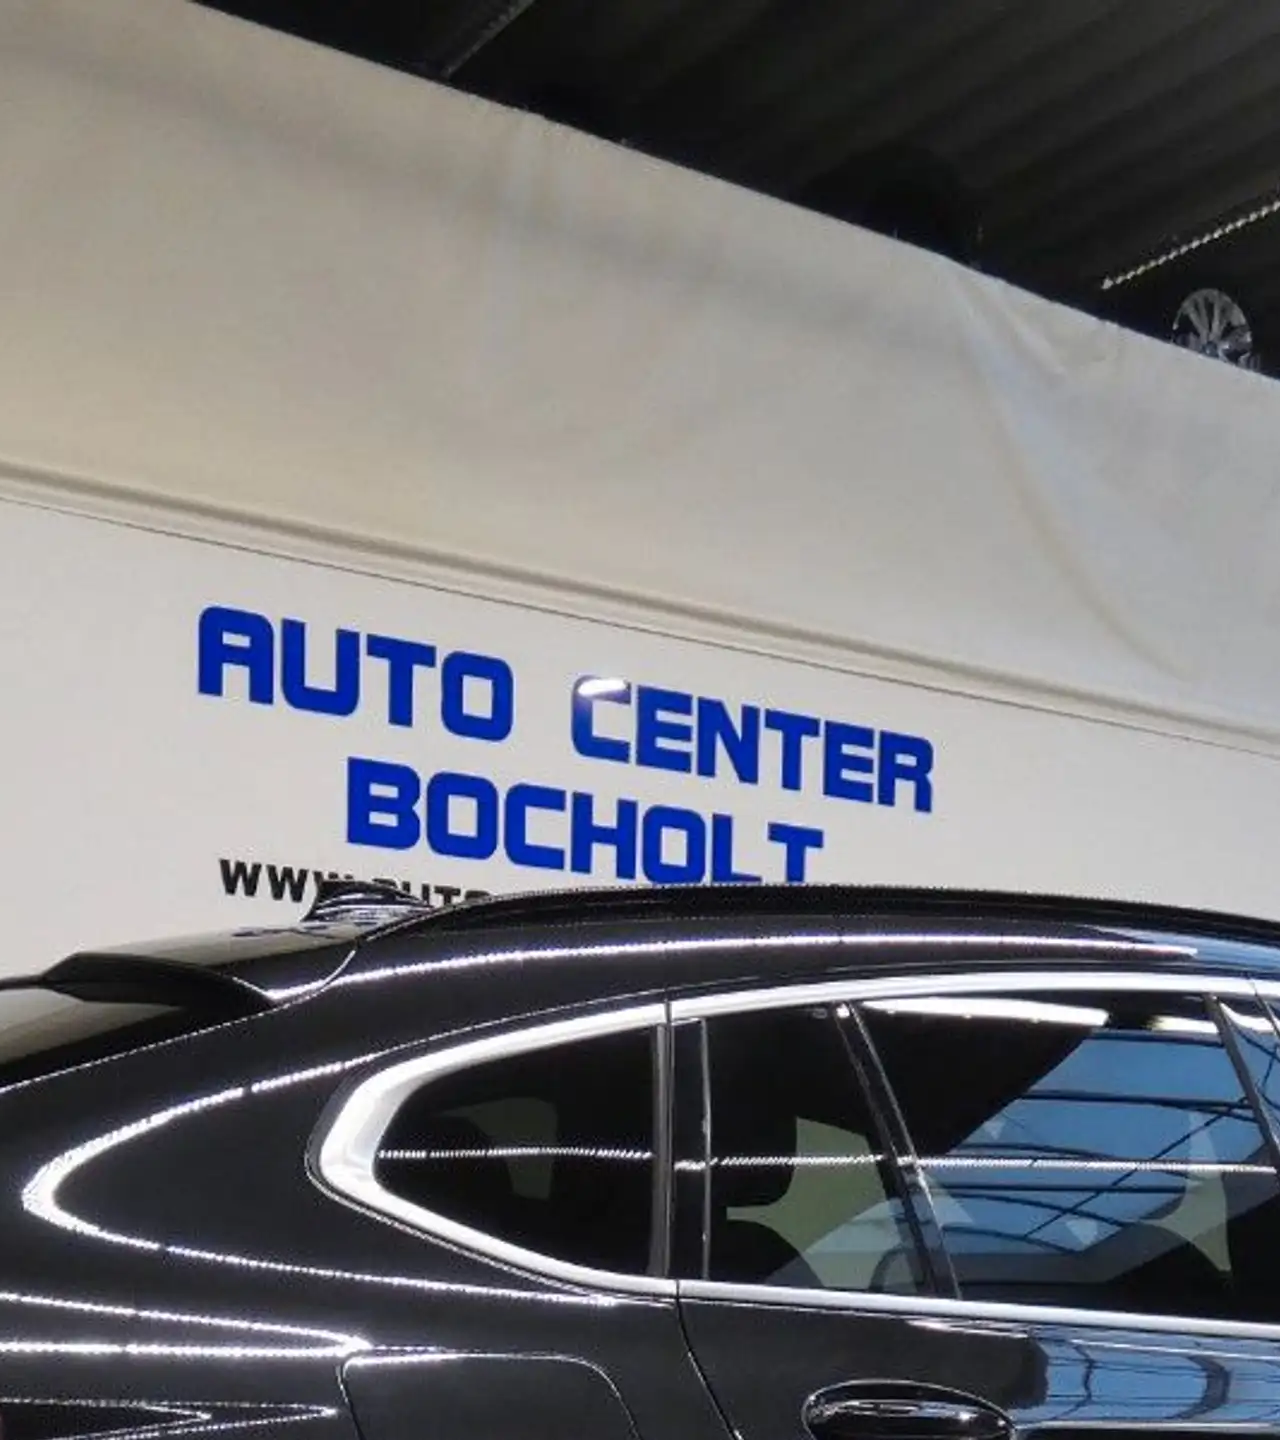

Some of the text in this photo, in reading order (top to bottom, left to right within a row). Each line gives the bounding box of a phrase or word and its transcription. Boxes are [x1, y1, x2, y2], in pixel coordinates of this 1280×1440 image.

[196, 605, 935, 814] AUTO CENTER
[346, 756, 826, 887] BOCHOLT
